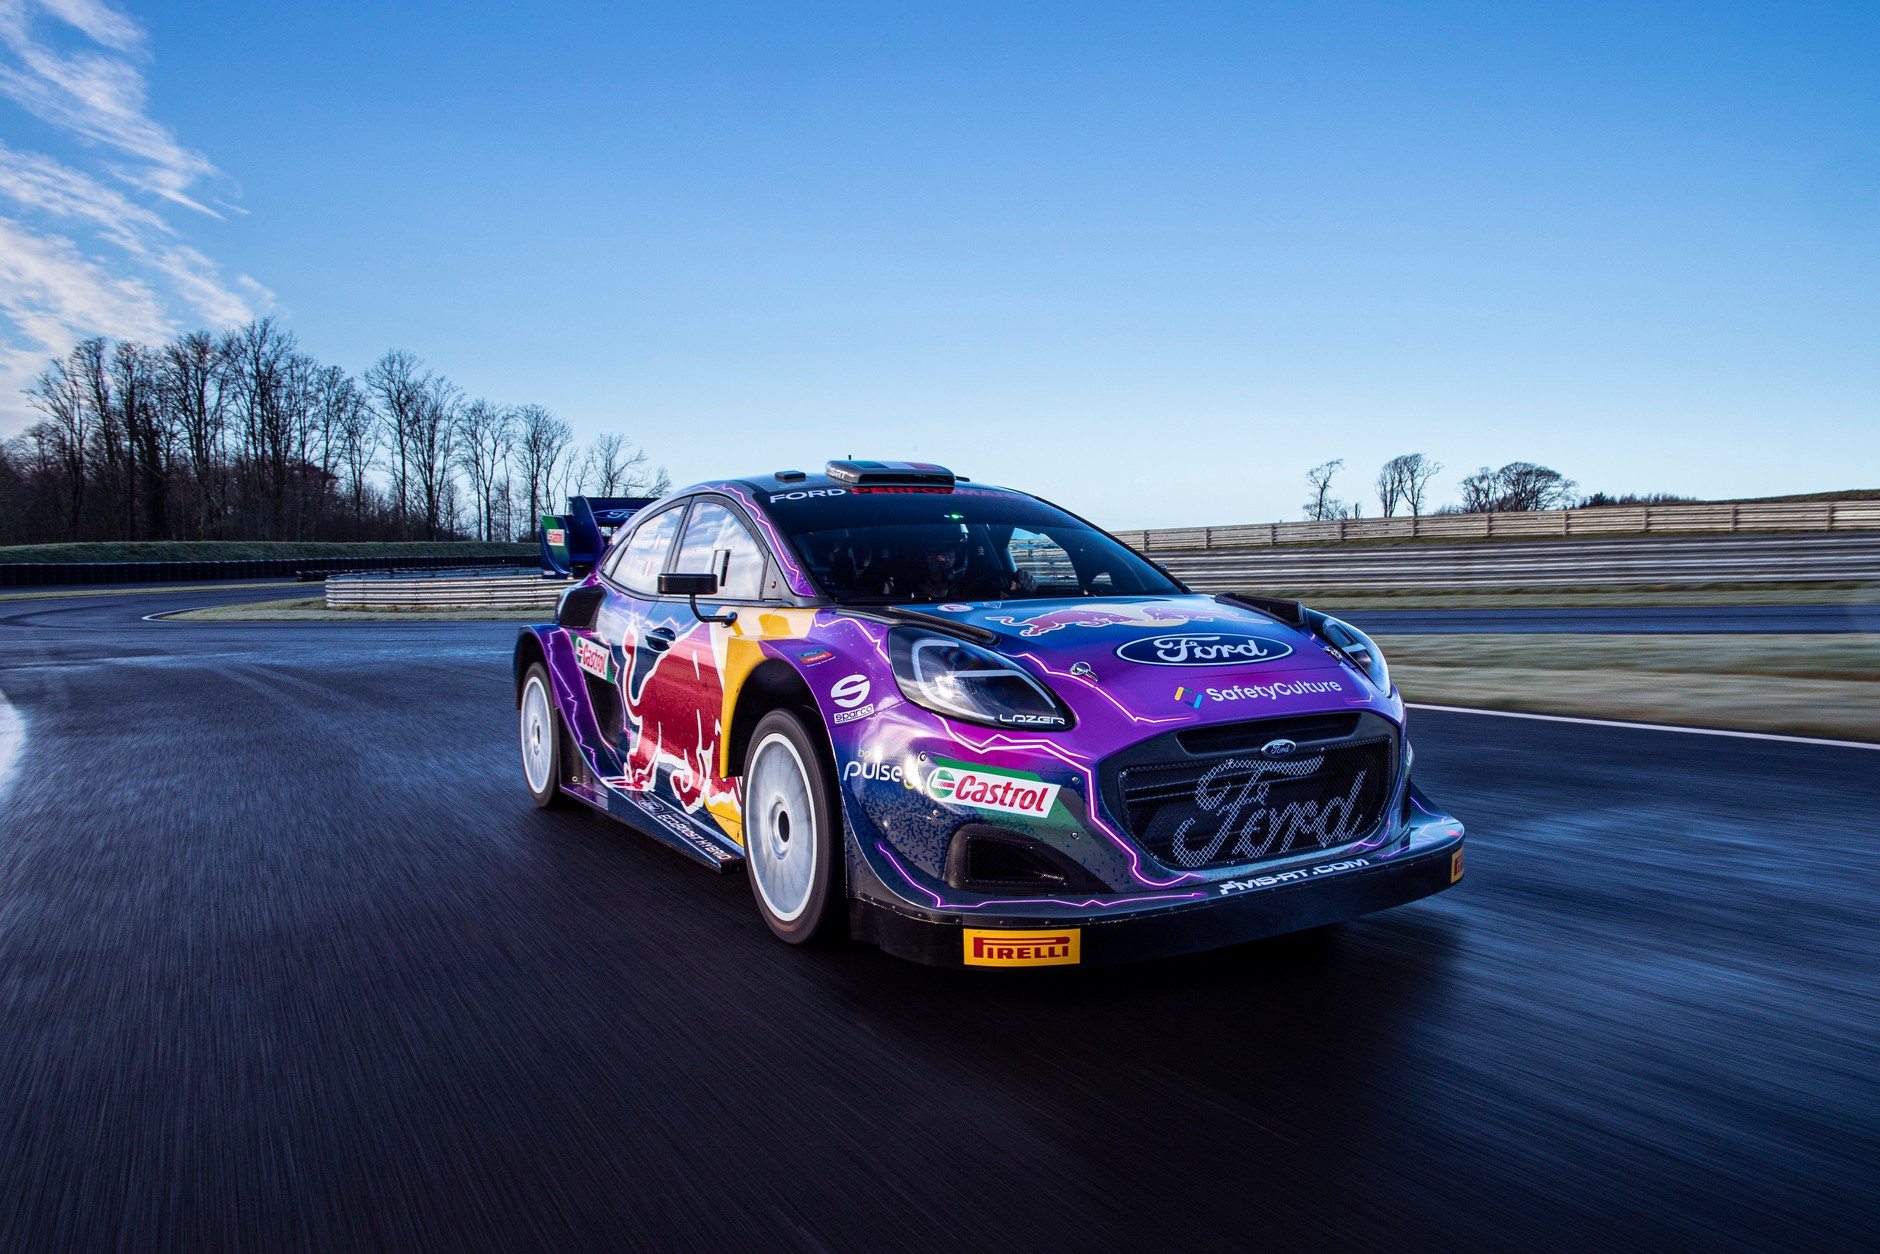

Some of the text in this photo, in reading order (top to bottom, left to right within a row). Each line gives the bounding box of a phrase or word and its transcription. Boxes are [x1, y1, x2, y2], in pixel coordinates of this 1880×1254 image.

[769, 488, 846, 503] FORD
[583, 643, 606, 675] Castrol
[1153, 636, 1267, 662] Ford
[1206, 680, 1342, 702] SafetyCulture
[835, 705, 873, 722] sparco
[1000, 714, 1065, 725] LAZER
[858, 748, 871, 759] bp
[1271, 743, 1291, 755] Ford
[843, 761, 903, 782] pulse
[955, 775, 1049, 812] Castrol
[1172, 755, 1367, 868] Ford
[973, 937, 1070, 959] PIRELLI
